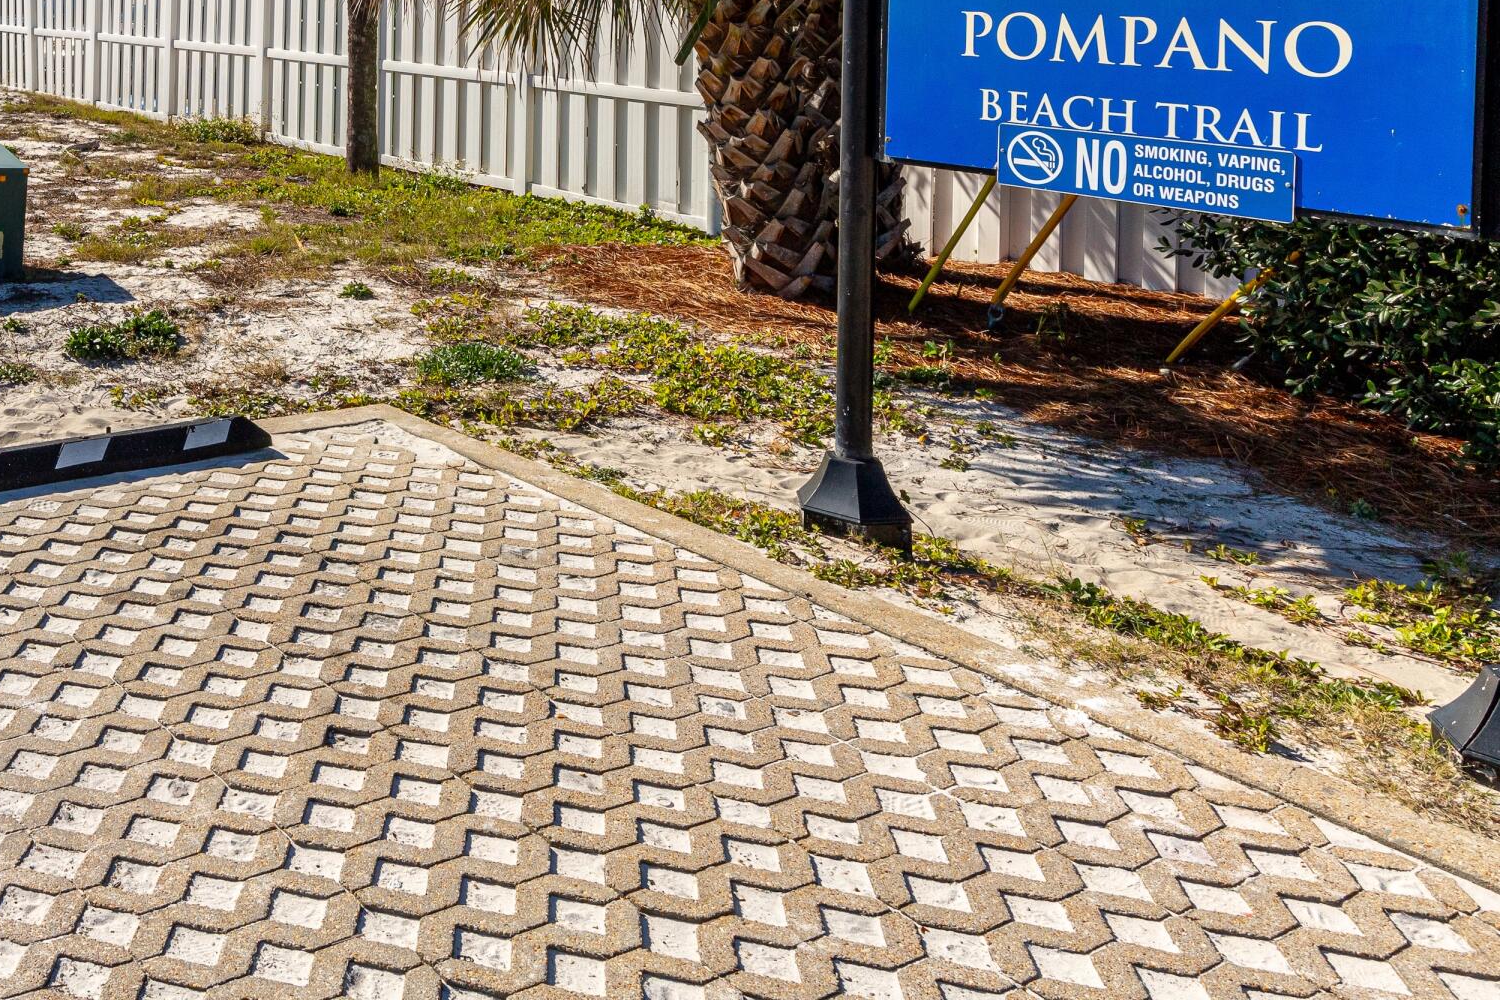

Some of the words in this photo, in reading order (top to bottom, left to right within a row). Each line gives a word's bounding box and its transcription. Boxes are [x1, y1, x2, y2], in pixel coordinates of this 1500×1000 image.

[960, 10, 1353, 79] POMPANO
[979, 88, 1138, 134] BEACH
[1155, 101, 1323, 153] TRAIL
[1075, 136, 1128, 195] NO
[1133, 163, 1211, 187] ALCOHOL,
[1216, 173, 1275, 193] DRUGS
[1134, 144, 1213, 168] SMOKING,
[1217, 153, 1285, 175] VAPING,
[1133, 182, 1155, 199] OR
[1158, 186, 1239, 209] WEAPONS
